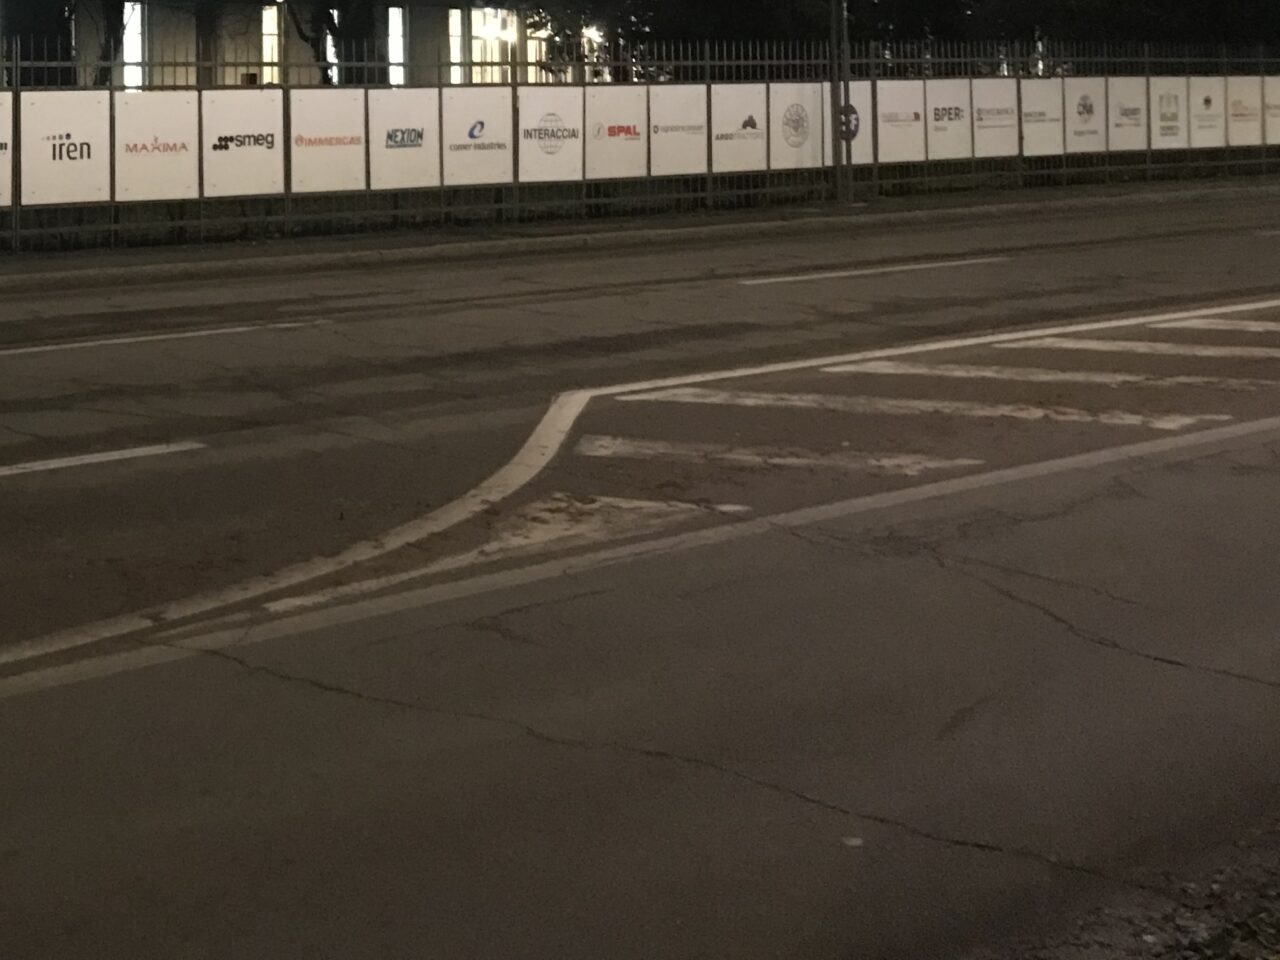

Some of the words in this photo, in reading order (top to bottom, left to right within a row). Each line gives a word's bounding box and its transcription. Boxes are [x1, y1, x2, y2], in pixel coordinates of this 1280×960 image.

[385, 128, 425, 145] NEXION
[607, 125, 641, 137] SPAL
[125, 142, 189, 153] MAXIMA
[234, 133, 275, 149] smeg
[52, 141, 92, 161] iren
